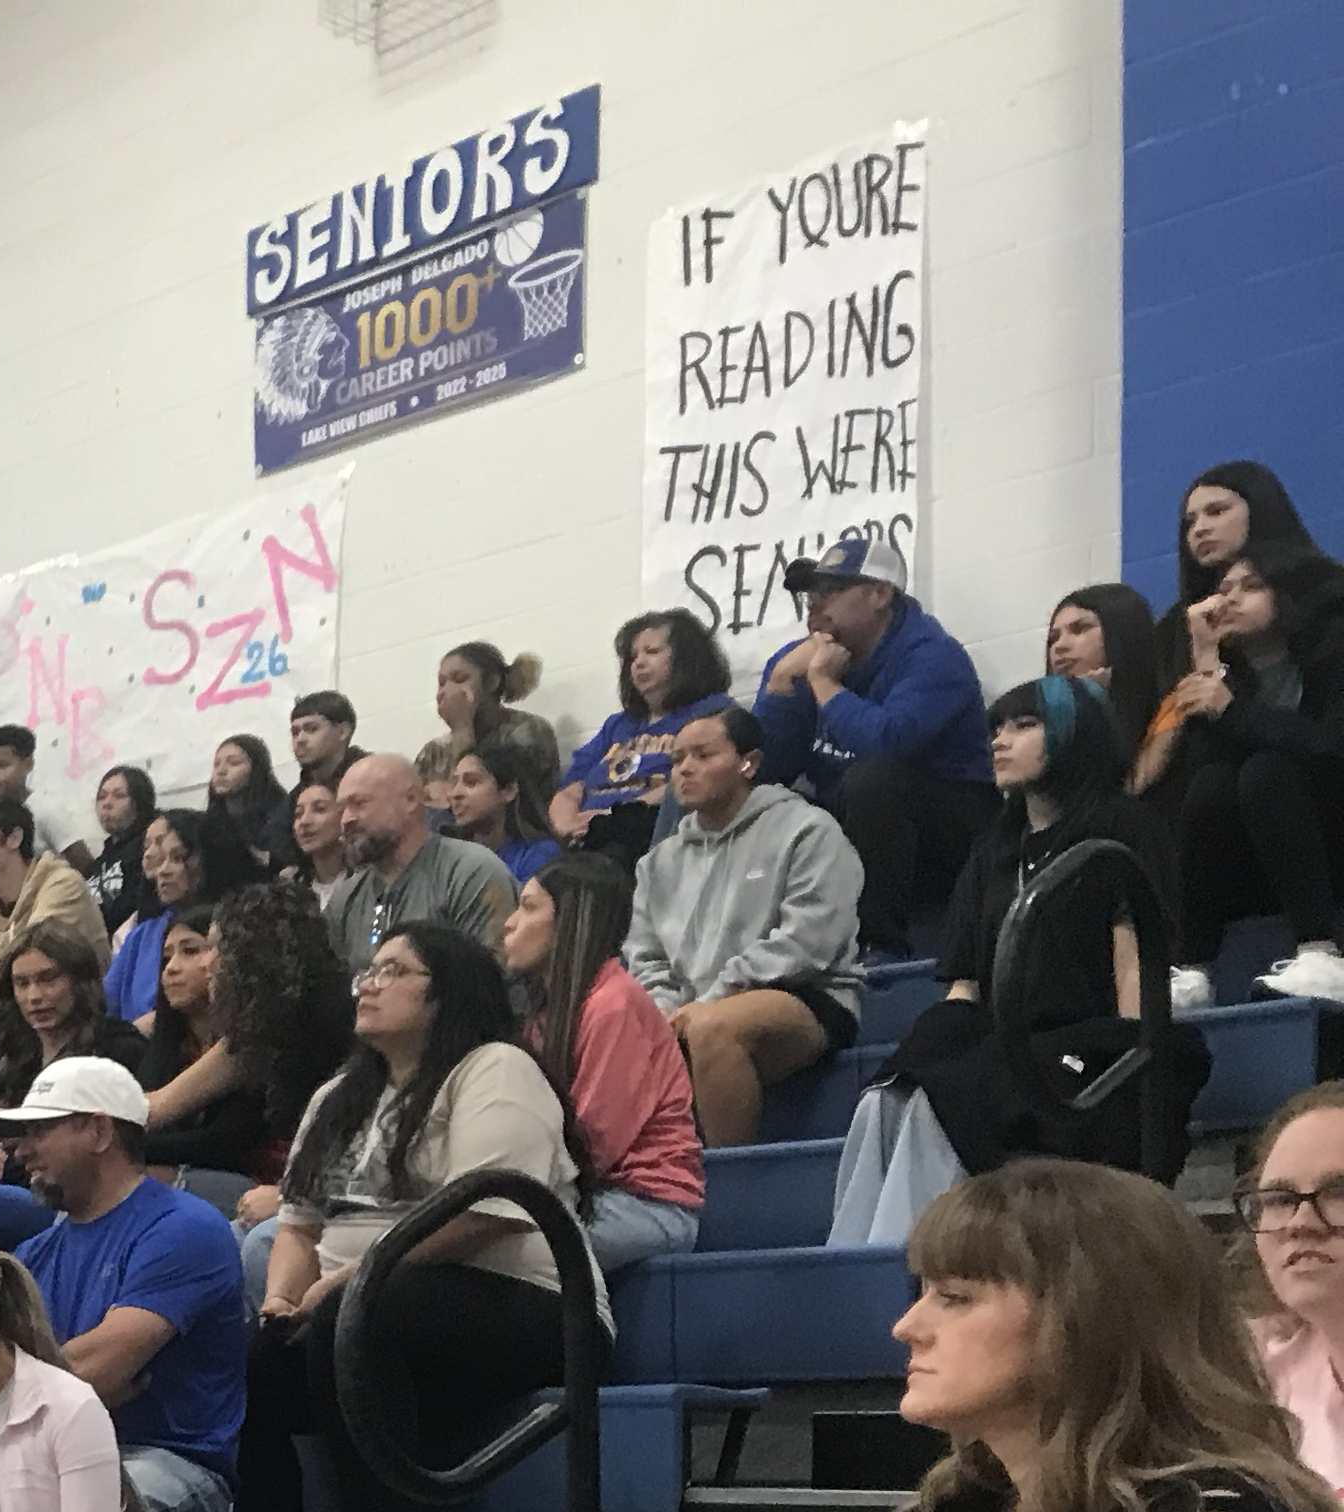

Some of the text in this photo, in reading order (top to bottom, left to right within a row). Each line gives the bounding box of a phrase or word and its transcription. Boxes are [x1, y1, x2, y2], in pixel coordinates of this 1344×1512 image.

[254, 101, 572, 305] SENIORS
[342, 238, 490, 314] JOSEPH DELGADO
[682, 207, 735, 287] IF
[335, 327, 499, 405] CAREER POINTS
[678, 269, 916, 415] READING
[301, 400, 398, 448] LAKE VIEW CHIEFS
[659, 397, 918, 523] THIS WERE
[684, 513, 914, 636] SENS
[240, 636, 290, 684] 26
